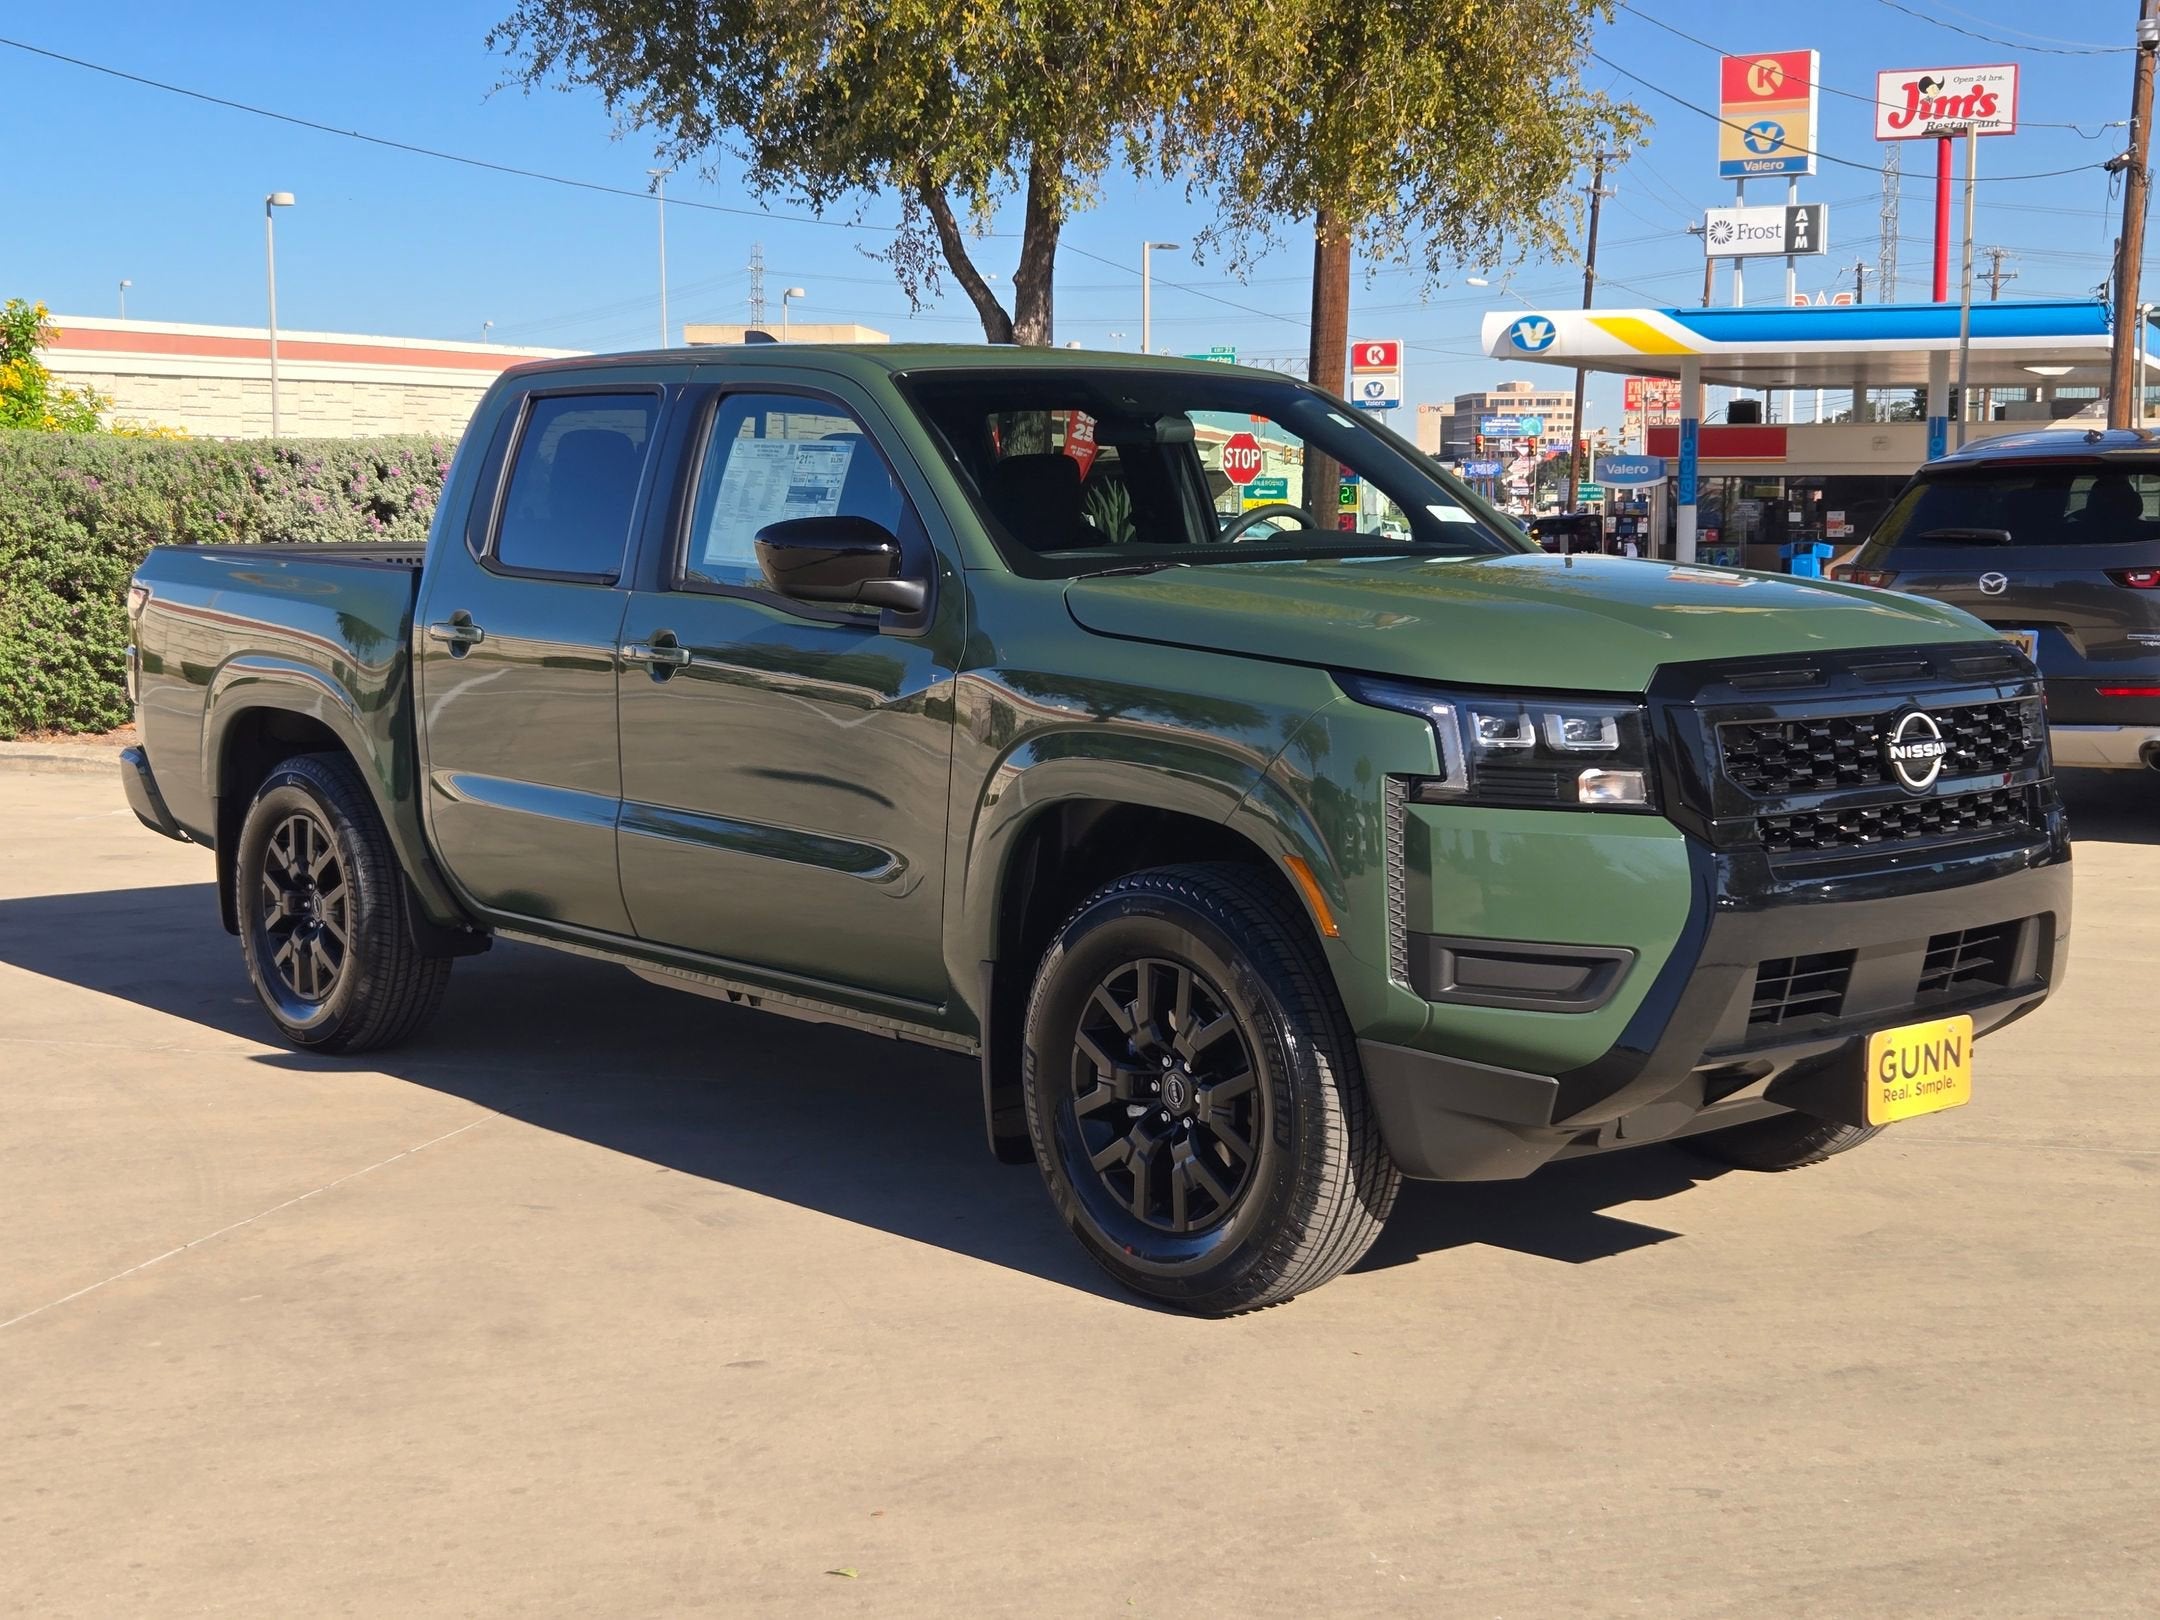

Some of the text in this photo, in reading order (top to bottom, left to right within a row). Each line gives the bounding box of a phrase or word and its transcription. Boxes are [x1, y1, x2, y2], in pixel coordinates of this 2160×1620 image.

[1953, 76, 1974, 84] Open
[1888, 81, 1999, 129] Jim's
[1743, 160, 1785, 171] Valero
[1736, 222, 1782, 240] Frost
[1794, 208, 1809, 249] ATM
[1224, 447, 1260, 469] STOP
[1606, 464, 1649, 475] Valero
[1679, 438, 1695, 503] Valero
[1889, 742, 1947, 759] NISSAN
[1879, 1036, 1962, 1084] GUNN
[1256, 1013, 1289, 1144] MICHELIN
[1883, 1074, 1956, 1103] Real. Simple.
[1025, 1049, 1053, 1172] MICHELIN
